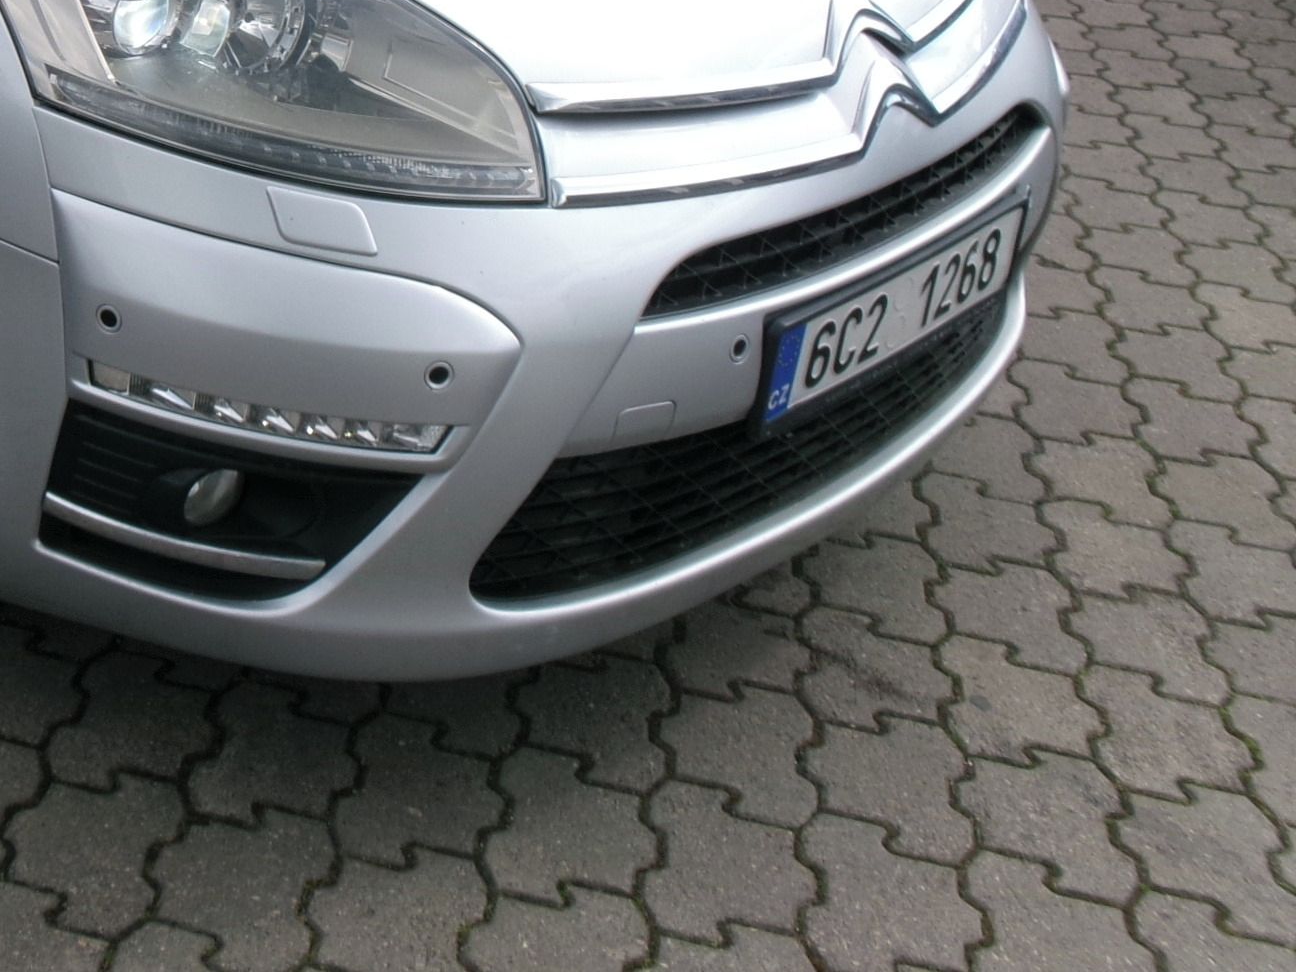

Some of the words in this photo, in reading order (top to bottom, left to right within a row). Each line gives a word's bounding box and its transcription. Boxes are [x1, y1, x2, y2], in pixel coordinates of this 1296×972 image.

[804, 293, 888, 388] 6C2
[921, 228, 1002, 327] 1268
[767, 383, 791, 411] CZ
